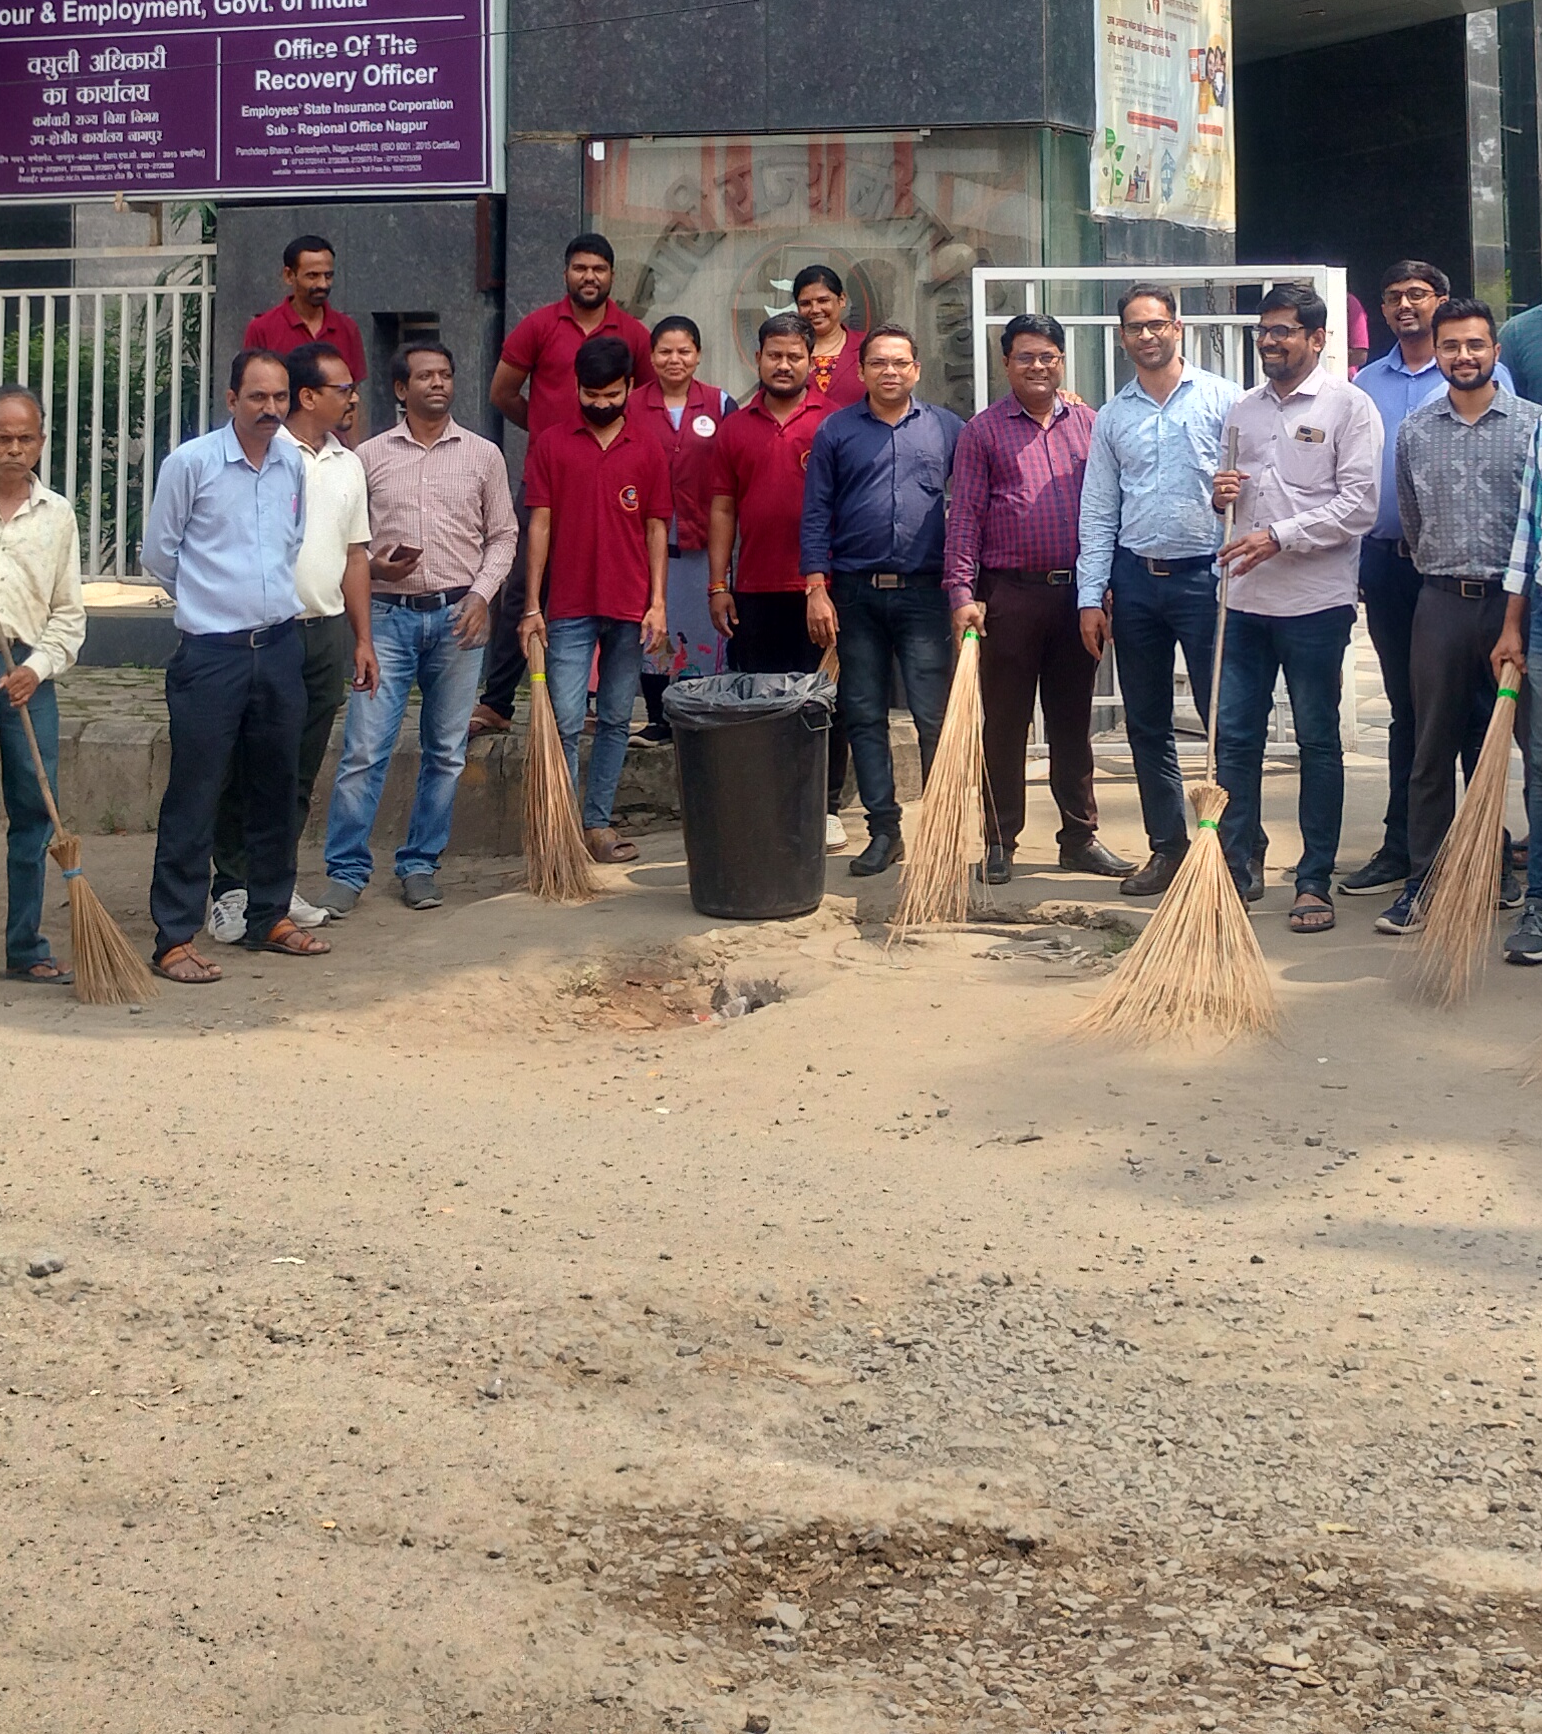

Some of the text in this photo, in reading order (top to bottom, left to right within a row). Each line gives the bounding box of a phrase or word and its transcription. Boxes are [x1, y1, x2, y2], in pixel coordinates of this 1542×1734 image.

[40, 2, 56, 24] &
[274, 33, 418, 60] Office Of The
[27, 44, 167, 80] वसुली अधिकारी
[255, 63, 438, 93] Recovery Officer
[42, 79, 150, 105] का कार्यालय
[32, 113, 70, 127] कर्मचारी
[75, 113, 99, 126] राज्य
[131, 109, 160, 123] निगम
[241, 98, 453, 119] Employees' State Insurance Corporation
[82, 129, 123, 144] कार्यालय
[266, 124, 288, 136] Sub
[297, 121, 347, 136] Regional
[349, 120, 383, 133] Office
[385, 119, 428, 134] Nagpur
